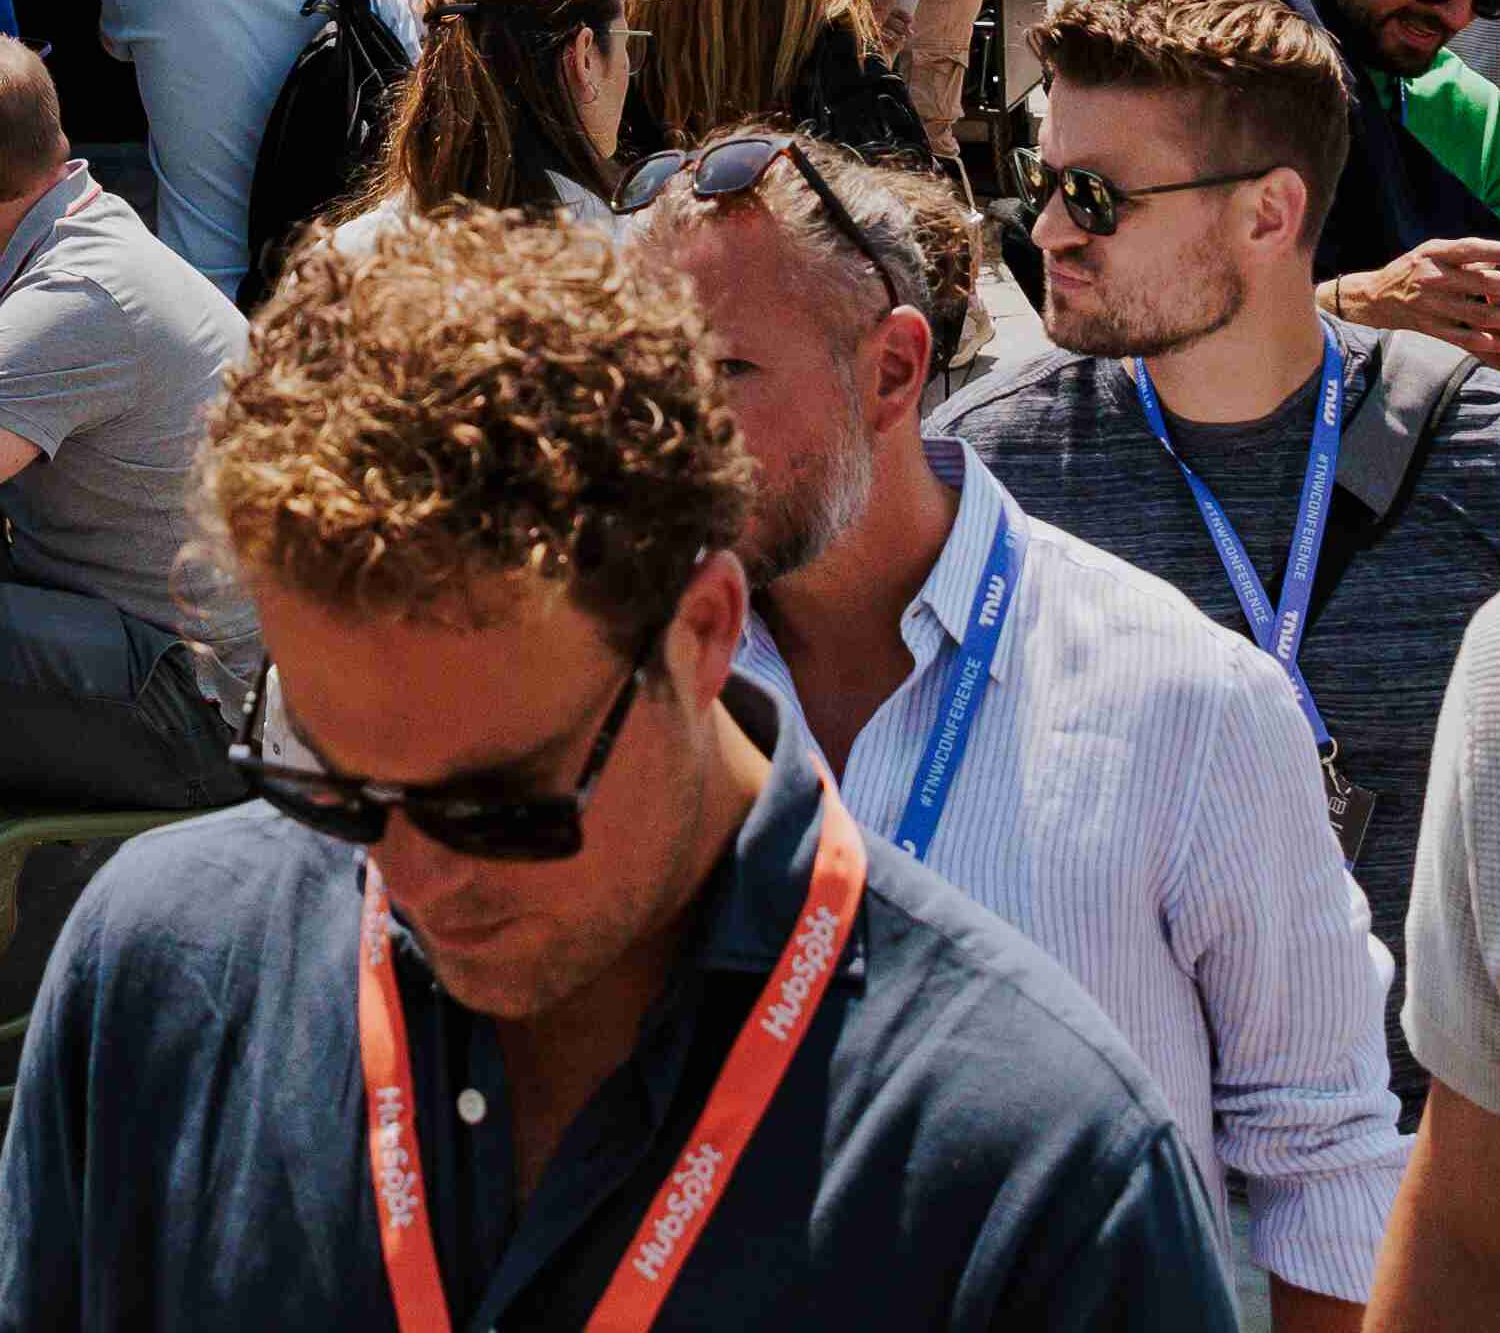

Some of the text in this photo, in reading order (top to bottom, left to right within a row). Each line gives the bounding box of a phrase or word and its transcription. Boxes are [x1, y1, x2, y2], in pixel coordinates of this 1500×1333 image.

[1323, 378, 1338, 427] TNW
[1201, 500, 1270, 627] #TNWCONFERENCE
[1293, 451, 1329, 582] #TNWCONFERENCE
[977, 573, 1006, 629] TNW
[1274, 609, 1299, 660] TNW
[919, 656, 983, 808] #TNWCONFERENCE
[759, 905, 842, 1042] HubSpot
[375, 1085, 421, 1230] HubSpot
[632, 1141, 725, 1281] HubSpot
